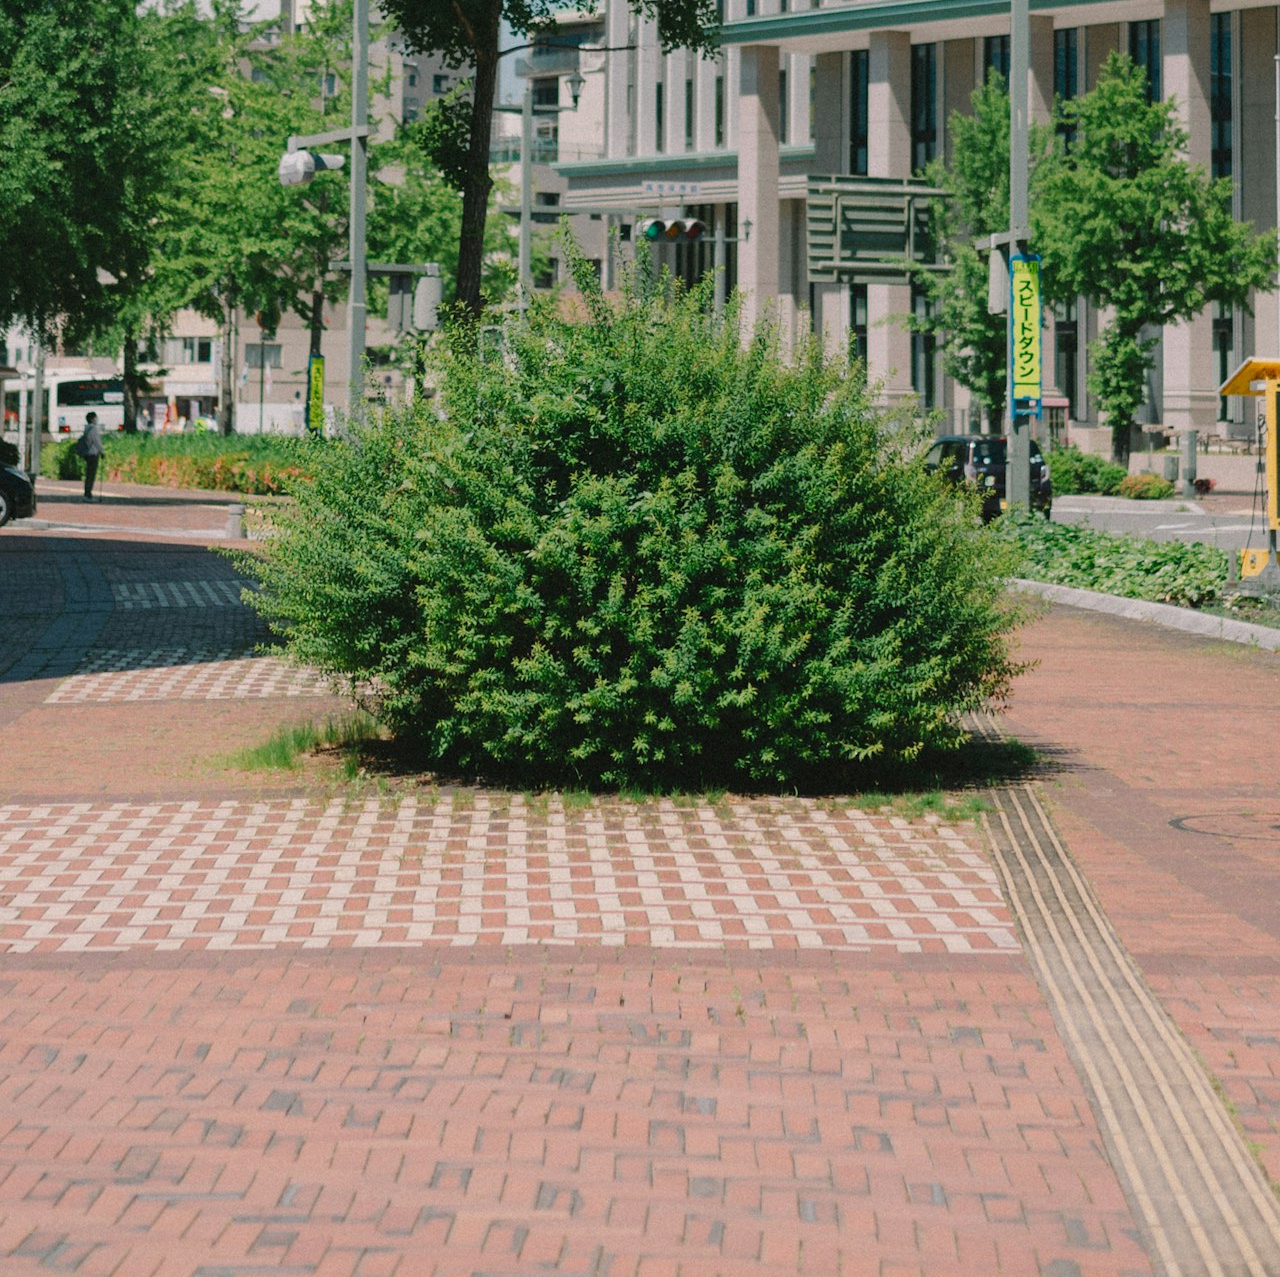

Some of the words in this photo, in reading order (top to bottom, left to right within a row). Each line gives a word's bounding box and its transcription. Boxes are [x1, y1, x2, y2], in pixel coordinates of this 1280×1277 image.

[1018, 279, 1035, 378] スピードダウン
